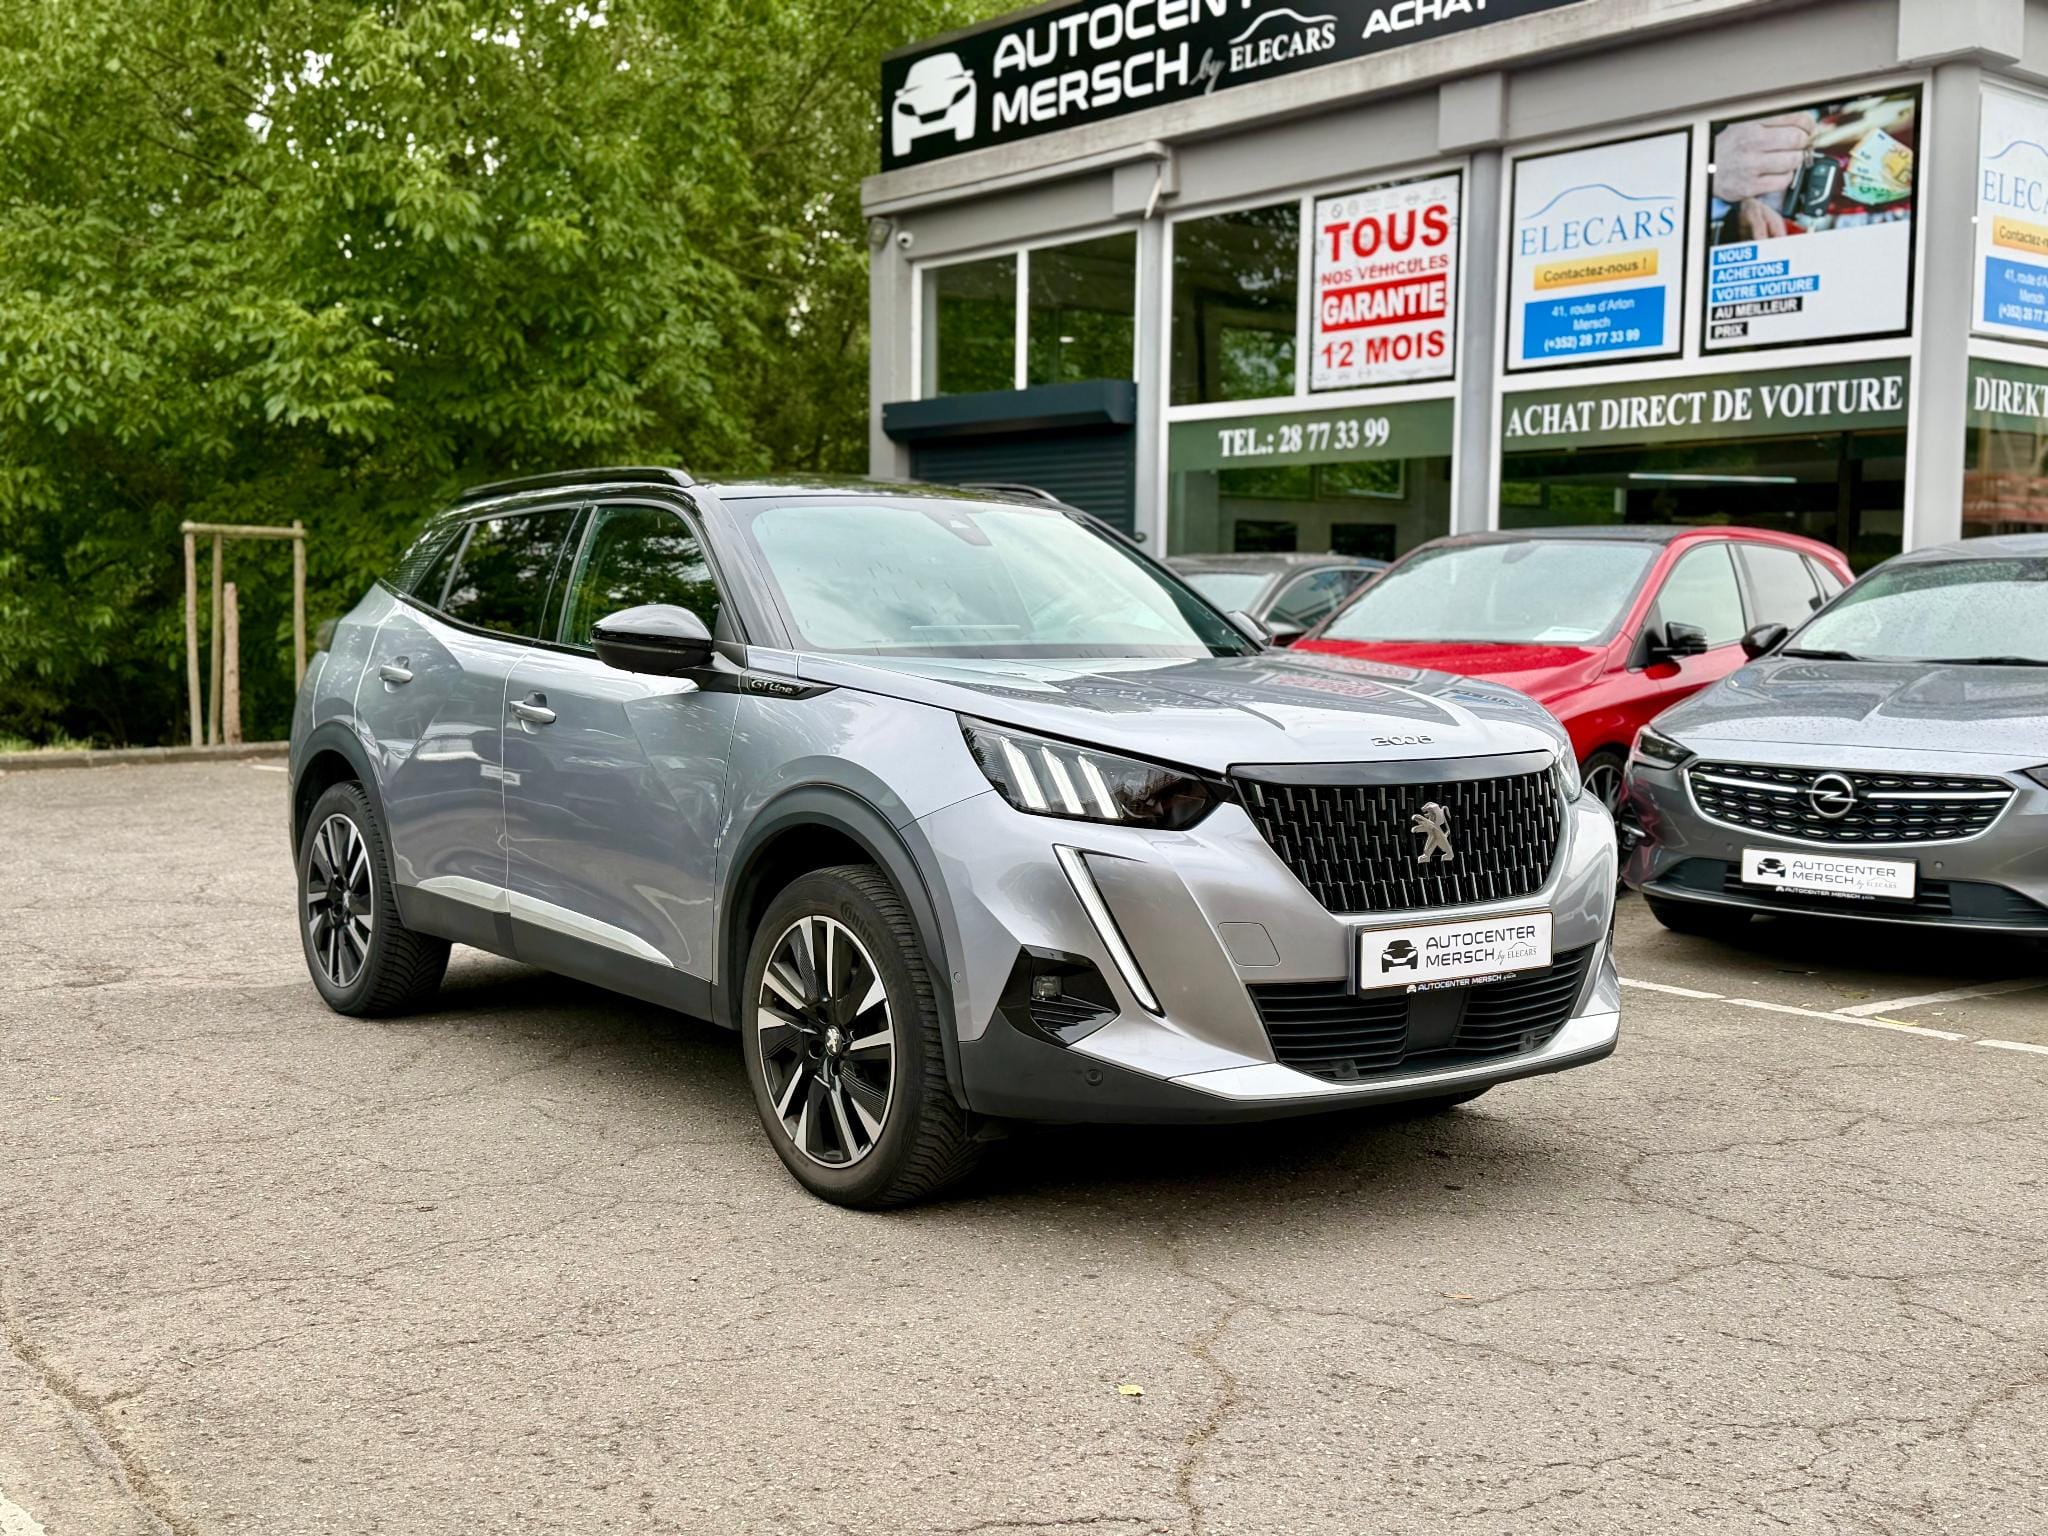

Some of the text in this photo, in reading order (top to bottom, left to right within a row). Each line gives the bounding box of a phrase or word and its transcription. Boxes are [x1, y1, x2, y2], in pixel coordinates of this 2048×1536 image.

[994, 0, 1251, 79] AUTOCEN
[992, 23, 1336, 132] MERSCH by ELECARS
[1984, 169, 2048, 214] ELEC
[1323, 204, 1450, 262] TOUS
[1519, 206, 1676, 256] ELECARS
[1717, 247, 1753, 263] NOUS
[1321, 269, 1353, 286] NOS
[1543, 260, 1639, 283] Contactez-nous
[1717, 262, 1784, 282] ACHETONS
[1716, 278, 1814, 300] VOTRE VOITURE
[1322, 281, 1446, 327] GARANTIE
[1569, 302, 1597, 316] route
[1715, 299, 1797, 319] AU MEILLEUR
[1573, 316, 1611, 331] Mersch
[1714, 324, 1744, 338] PRIX
[1595, 331, 1609, 345] 77
[1610, 330, 1624, 343] 33
[1322, 330, 1445, 369] 12 MOIS
[1505, 376, 1903, 437] ACHAT DIRECT DE VOITURE
[1218, 417, 1390, 457] TEL.: 28 77 33 99
[751, 679, 769, 690] GT
[1792, 860, 1896, 878] AUTOCENTER
[1792, 871, 1854, 885] MERSCH
[1785, 887, 1829, 897] AUTOCENTER
[1831, 891, 1860, 900] MERSCH
[1426, 925, 1536, 950] AUTOCENTER
[1425, 948, 1495, 968] MERSCH
[1507, 948, 1537, 959] ELECARS
[1418, 978, 1470, 991] AUTOCENTER
[1471, 974, 1502, 985] MERSCH
